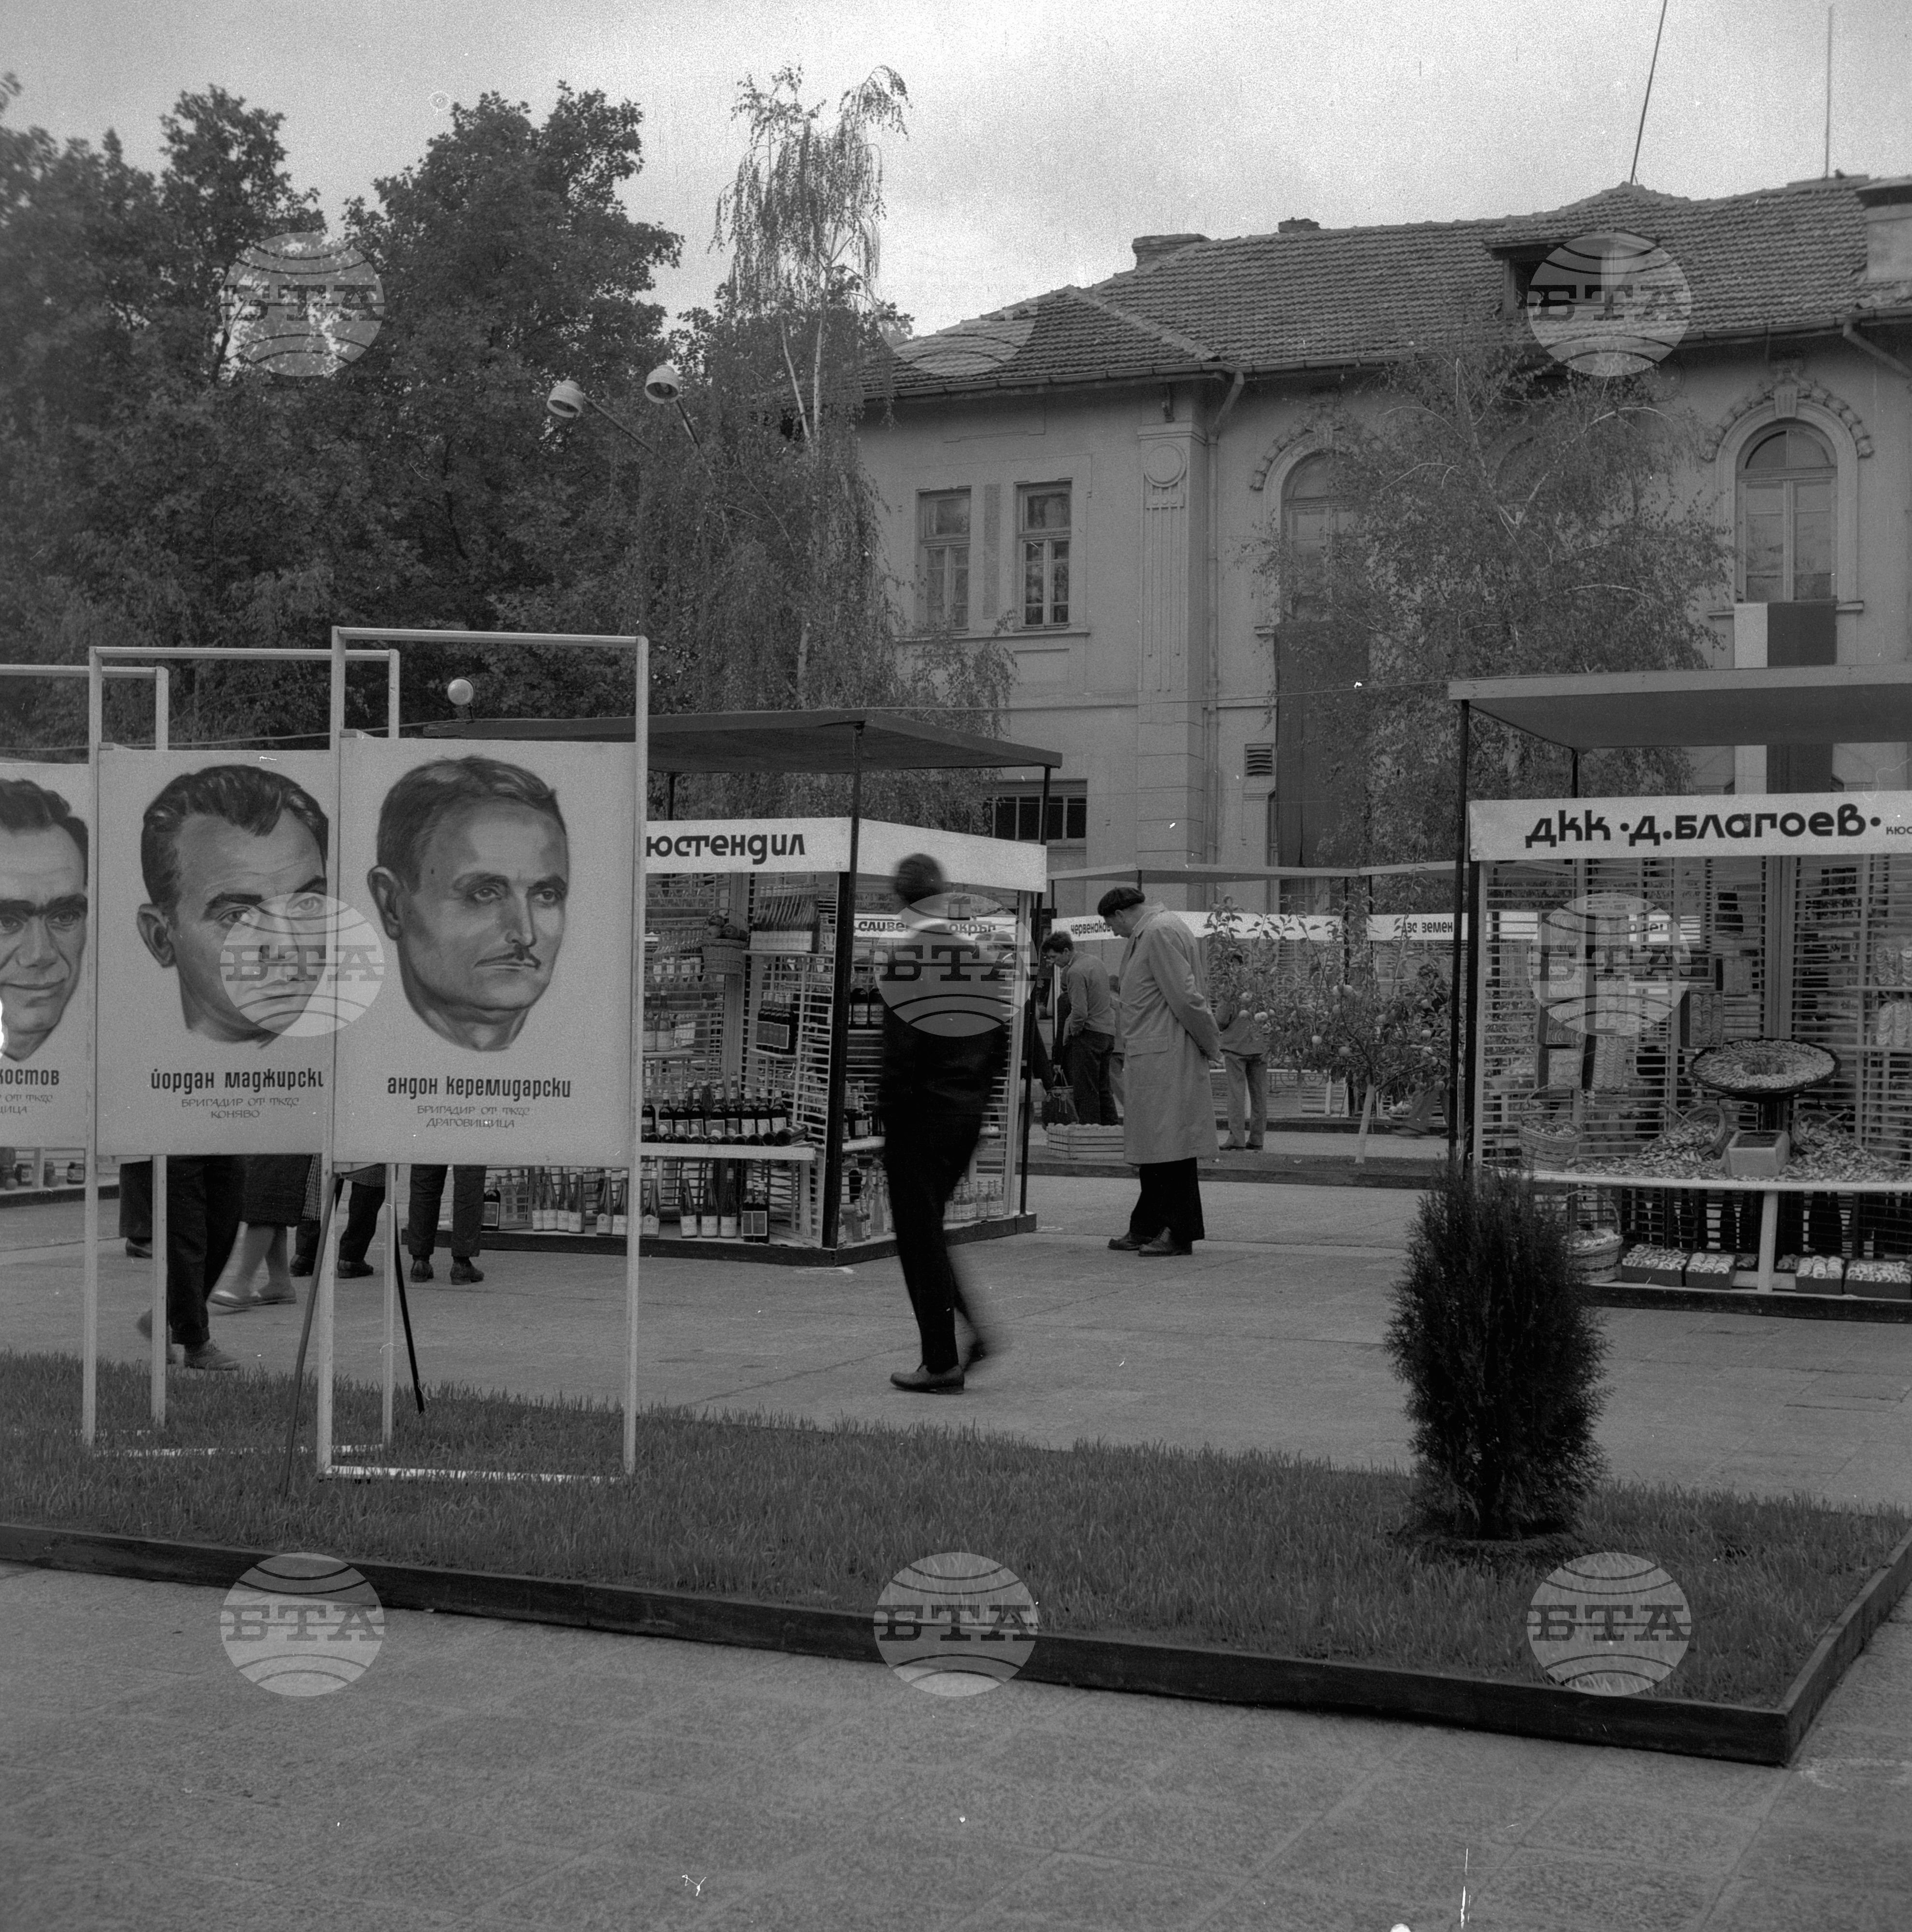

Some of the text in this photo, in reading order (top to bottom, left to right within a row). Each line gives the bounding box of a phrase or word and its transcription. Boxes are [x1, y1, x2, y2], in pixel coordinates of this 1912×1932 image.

[646, 834, 805, 865] юстендил
[388, 1077, 437, 1099] андон
[5, 1094, 21, 1102] ОТ
[182, 1098, 243, 1108] БРИГАДИР
[248, 1098, 265, 1106] ОТ
[211, 1110, 260, 1119] КОНЯВО
[417, 1105, 475, 1115] БРИГАДИР
[481, 1107, 496, 1115] ОТ
[426, 1118, 515, 1128] ДРАГОВИЩИЦА
